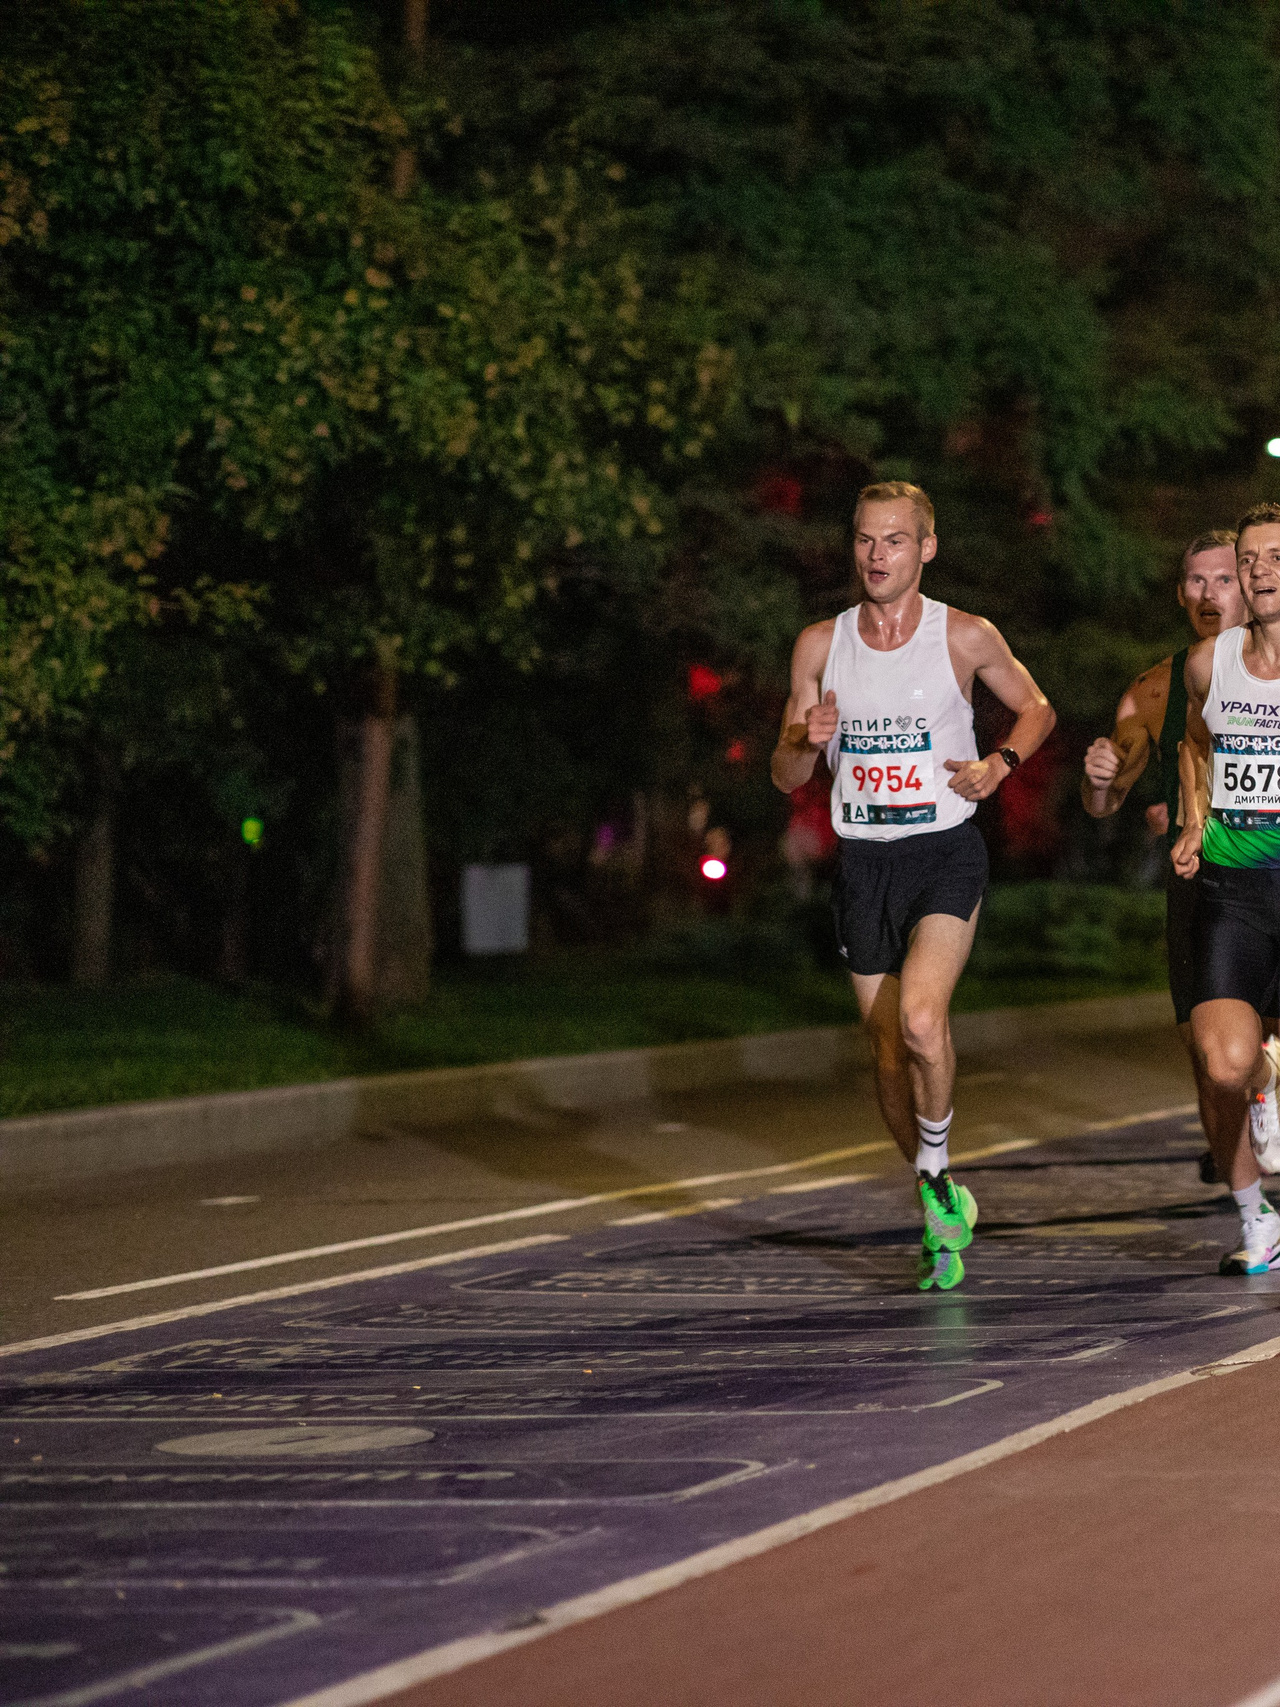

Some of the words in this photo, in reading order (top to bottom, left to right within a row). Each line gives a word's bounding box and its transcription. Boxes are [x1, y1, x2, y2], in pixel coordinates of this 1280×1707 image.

[846, 732, 925, 751] НОЧНОЙ
[852, 765, 923, 793] 9954
[1234, 795, 1280, 805] ДМИТРИЙ
